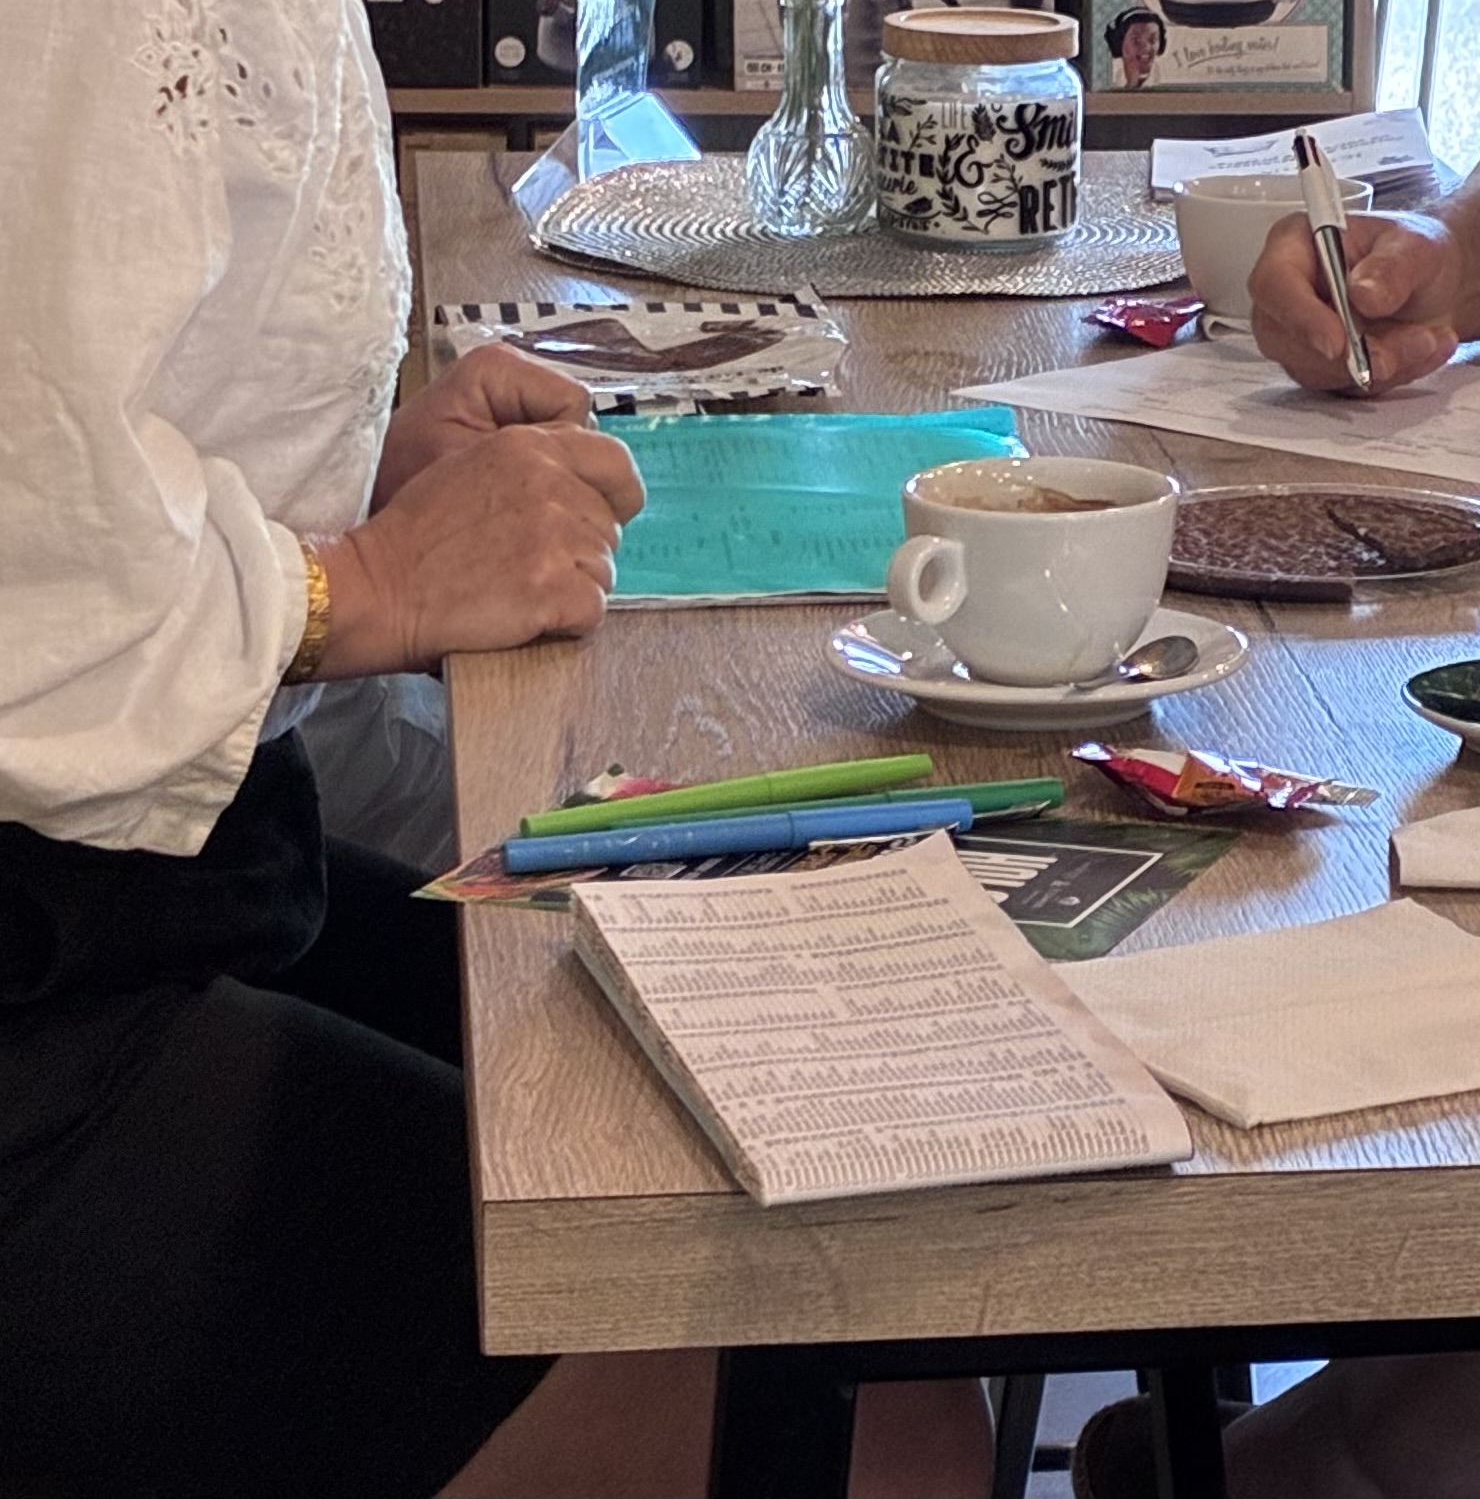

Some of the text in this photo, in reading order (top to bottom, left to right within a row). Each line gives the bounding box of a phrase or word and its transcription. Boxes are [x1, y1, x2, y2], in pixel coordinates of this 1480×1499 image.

[941, 102, 967, 129] LIFE
[996, 102, 1074, 161] Smi
[1019, 171, 1078, 235] RET
